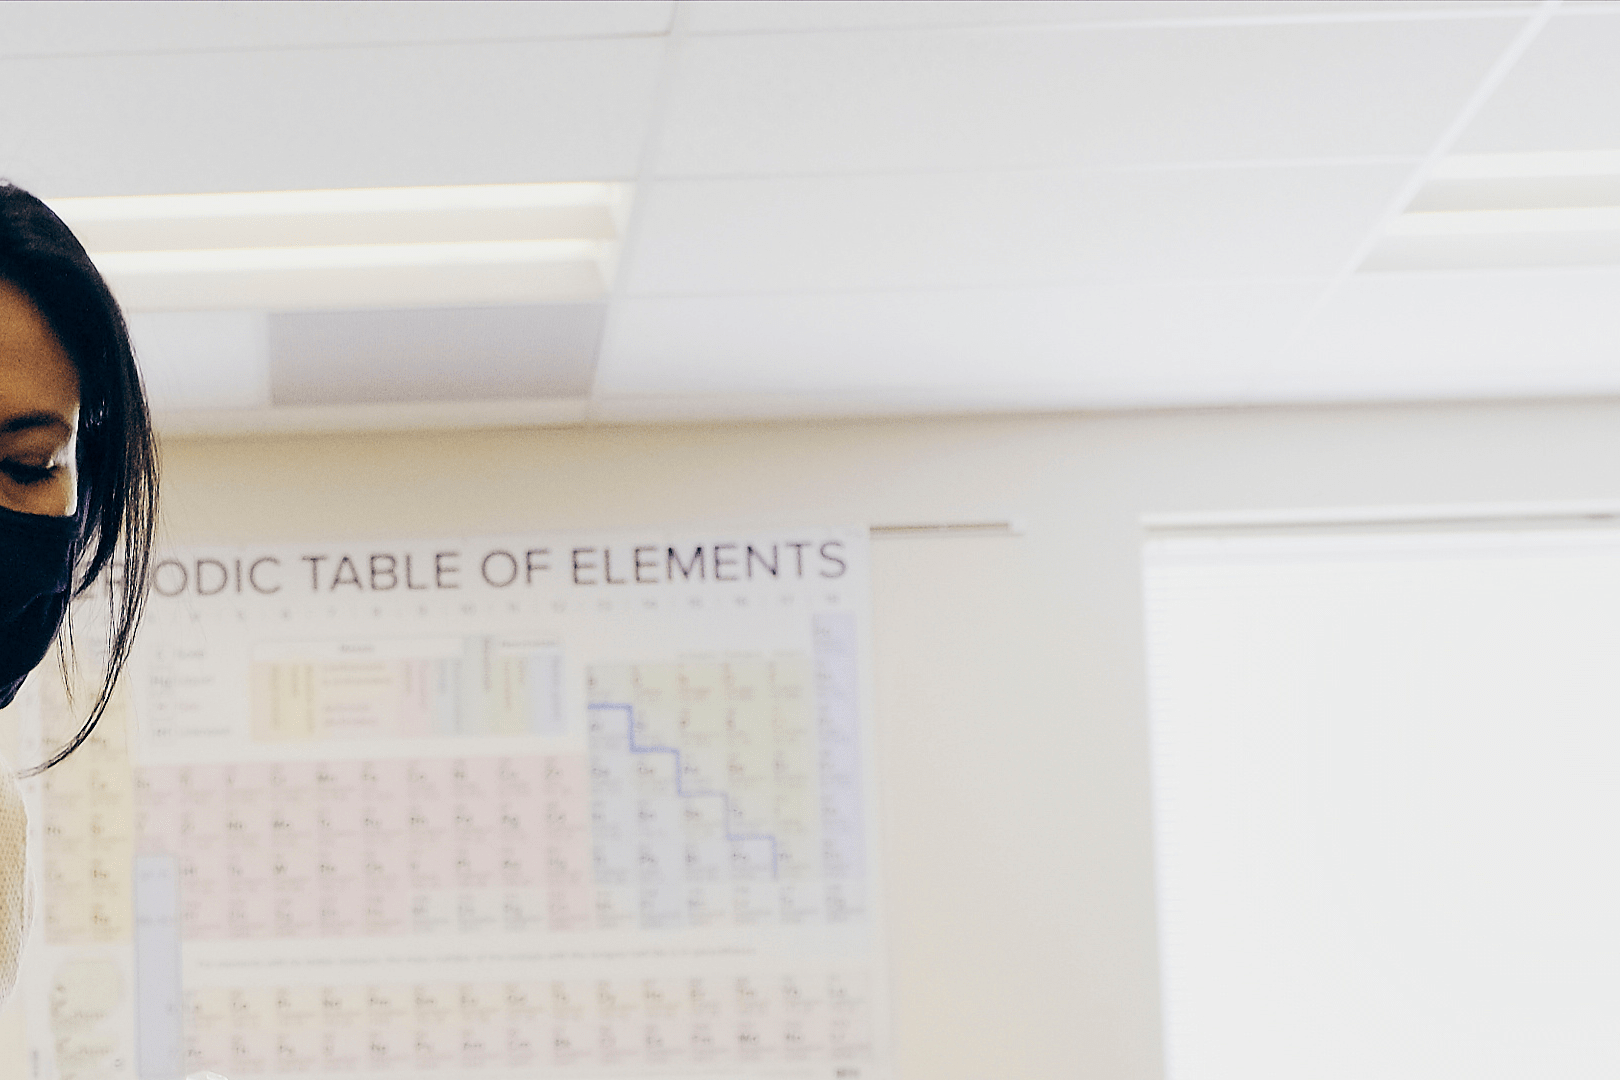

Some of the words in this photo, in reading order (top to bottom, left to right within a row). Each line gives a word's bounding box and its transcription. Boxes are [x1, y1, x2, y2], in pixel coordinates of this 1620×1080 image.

[301, 551, 461, 592] TABLE
[481, 547, 552, 588] OF
[571, 540, 848, 586] ELEMENTS
